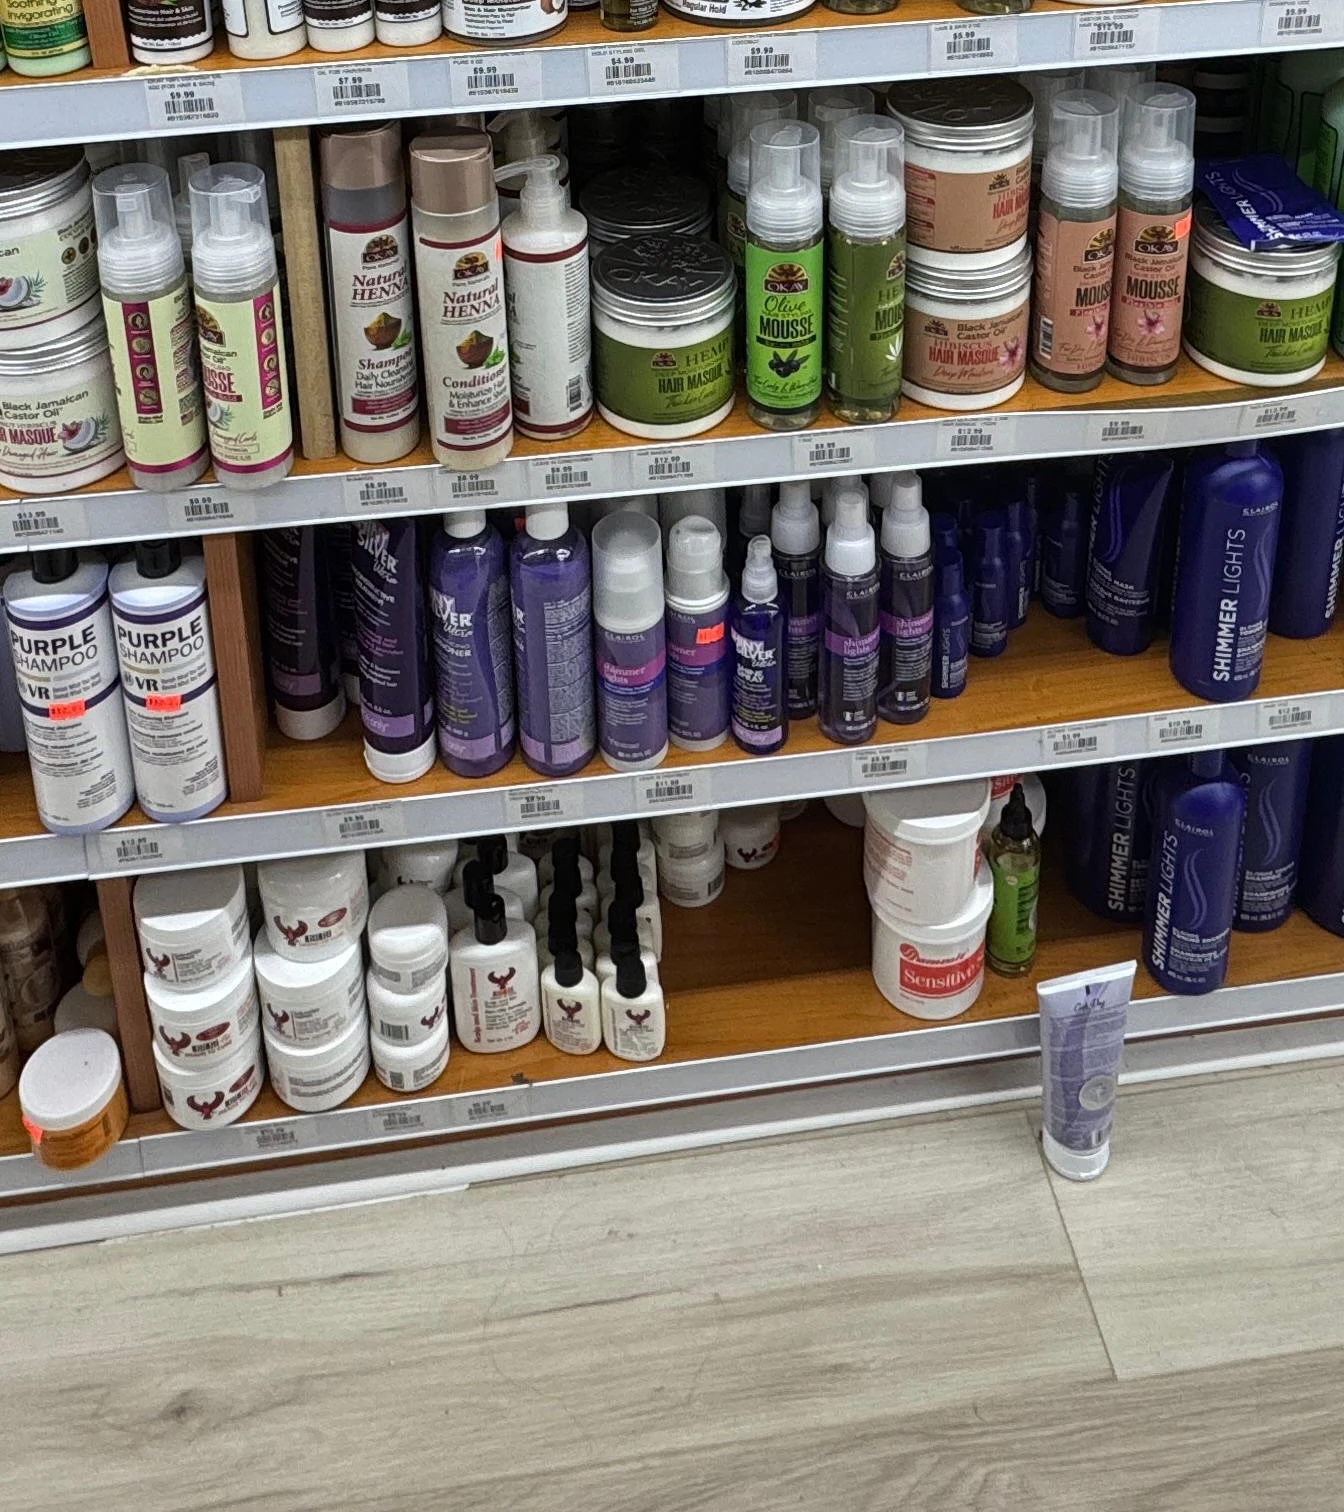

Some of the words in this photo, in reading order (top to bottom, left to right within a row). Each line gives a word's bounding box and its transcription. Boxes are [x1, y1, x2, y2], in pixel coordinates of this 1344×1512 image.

[8, 3, 72, 20] Invigorating
[444, 283, 497, 305] Natural
[1127, 277, 1179, 298] MOUSSE
[443, 295, 500, 318] HENNA
[765, 295, 807, 313] Olive
[759, 317, 813, 339] MOUSSE
[657, 376, 683, 393] HAIR
[687, 366, 723, 387] MASQUE
[10, 428, 57, 443] MASQUE
[1223, 529, 1246, 592] LIGHTS
[119, 617, 202, 648] PURPLE
[1214, 599, 1238, 682] SHIMMER
[120, 637, 204, 664] SHAMPOO
[904, 964, 977, 988] Sensitive
